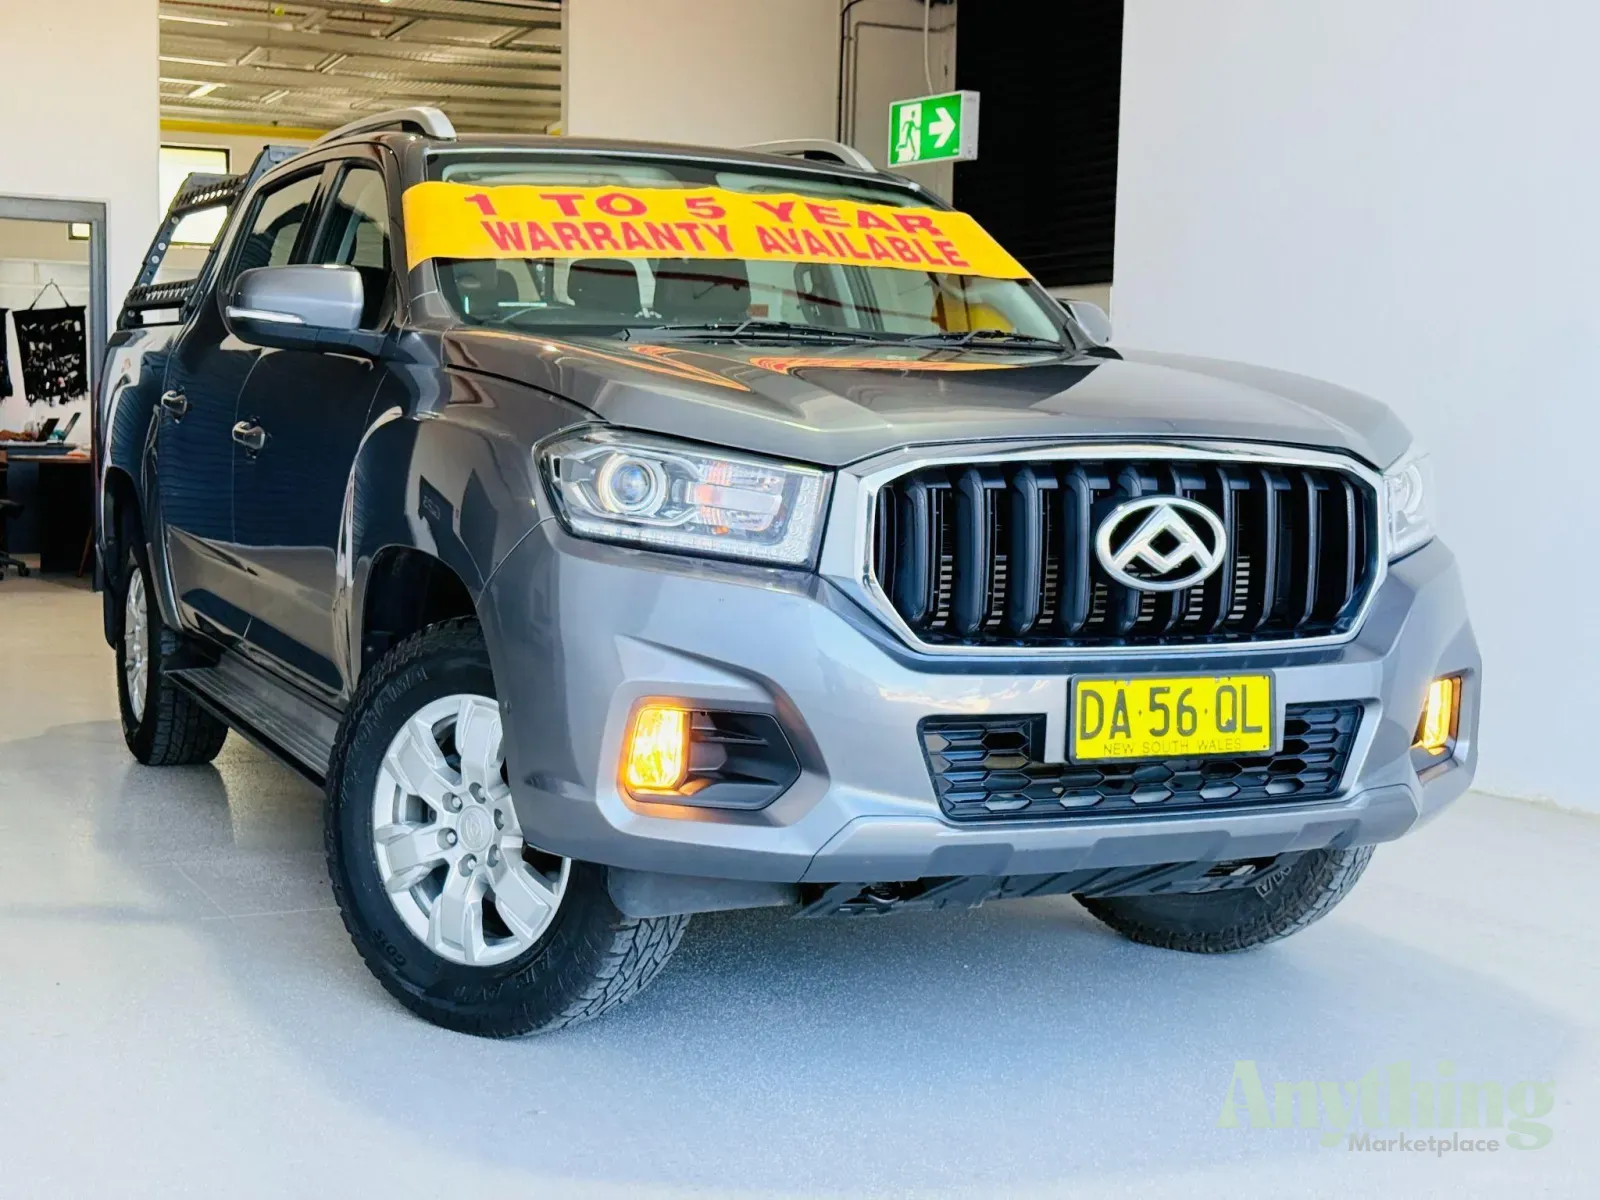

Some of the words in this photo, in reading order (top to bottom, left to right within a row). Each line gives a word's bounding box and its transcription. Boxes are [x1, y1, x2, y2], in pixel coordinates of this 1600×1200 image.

[464, 193, 497, 216] 1
[539, 193, 648, 217] TO
[684, 197, 727, 220] 5
[752, 200, 944, 236] YEAR
[480, 221, 734, 252] WARRANTY
[755, 225, 970, 268] AVAILABLE
[1103, 742, 1134, 756] NEW
[1142, 740, 1189, 754] SOUTH
[1197, 738, 1242, 751] WALES
